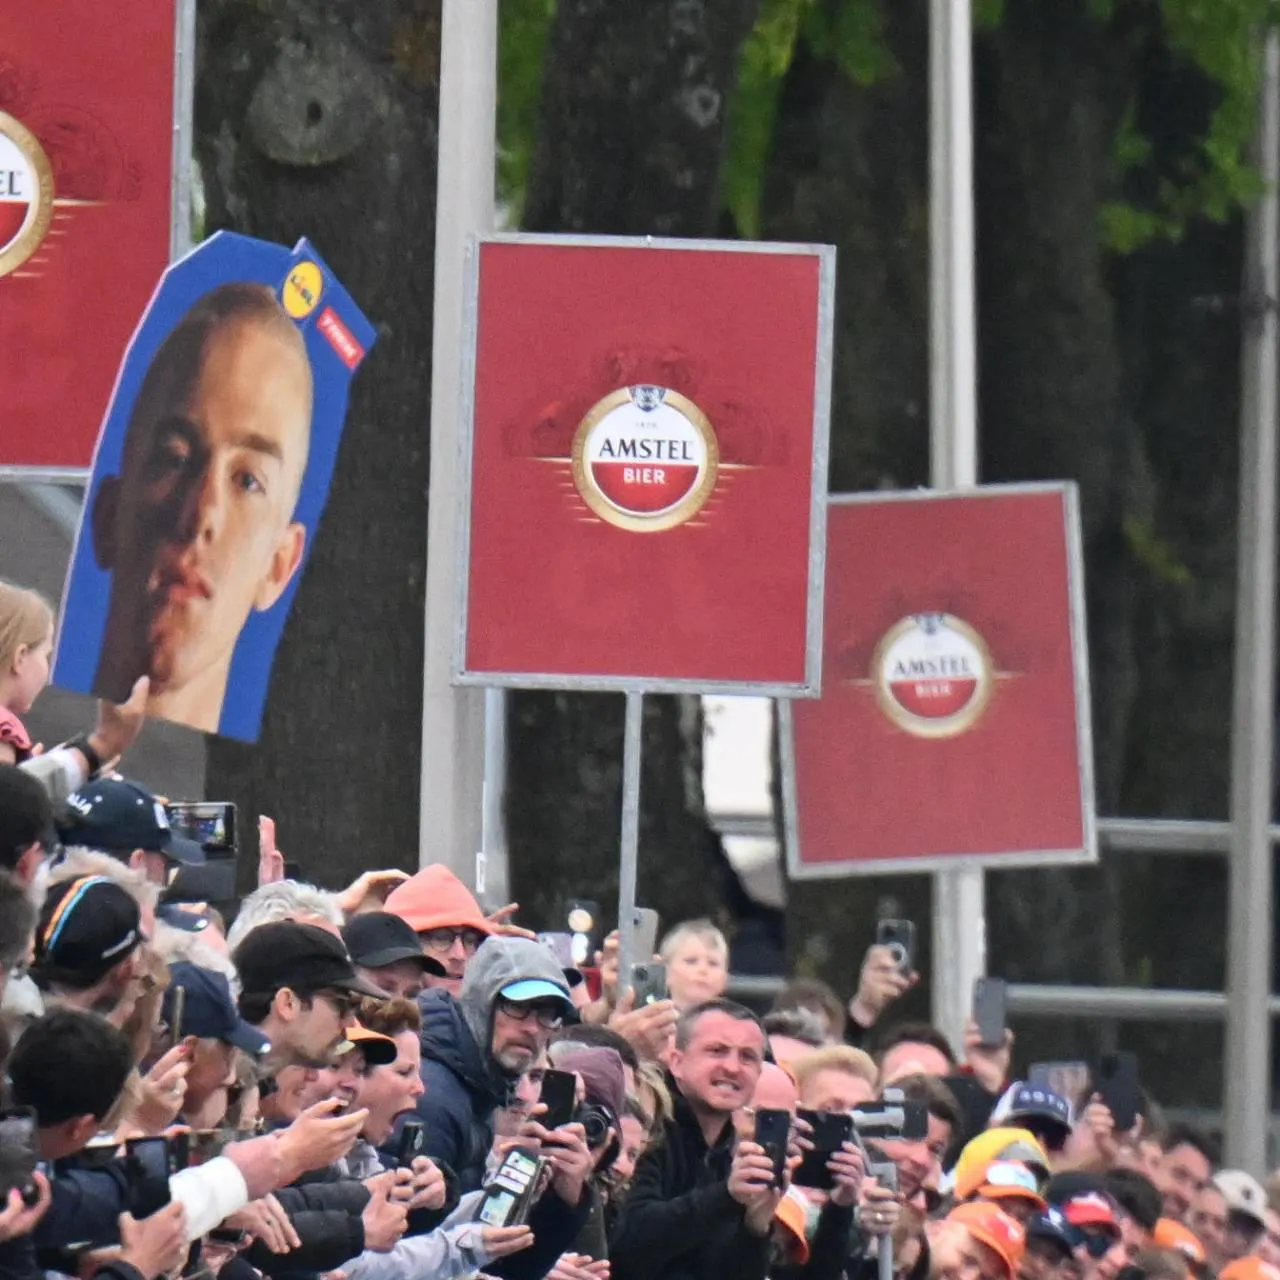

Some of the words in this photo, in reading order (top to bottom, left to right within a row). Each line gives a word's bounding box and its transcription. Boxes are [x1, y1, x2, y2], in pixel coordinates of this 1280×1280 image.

[599, 437, 694, 461] AMSTEL
[623, 467, 666, 485] BIER
[894, 655, 970, 675] AMSTEL
